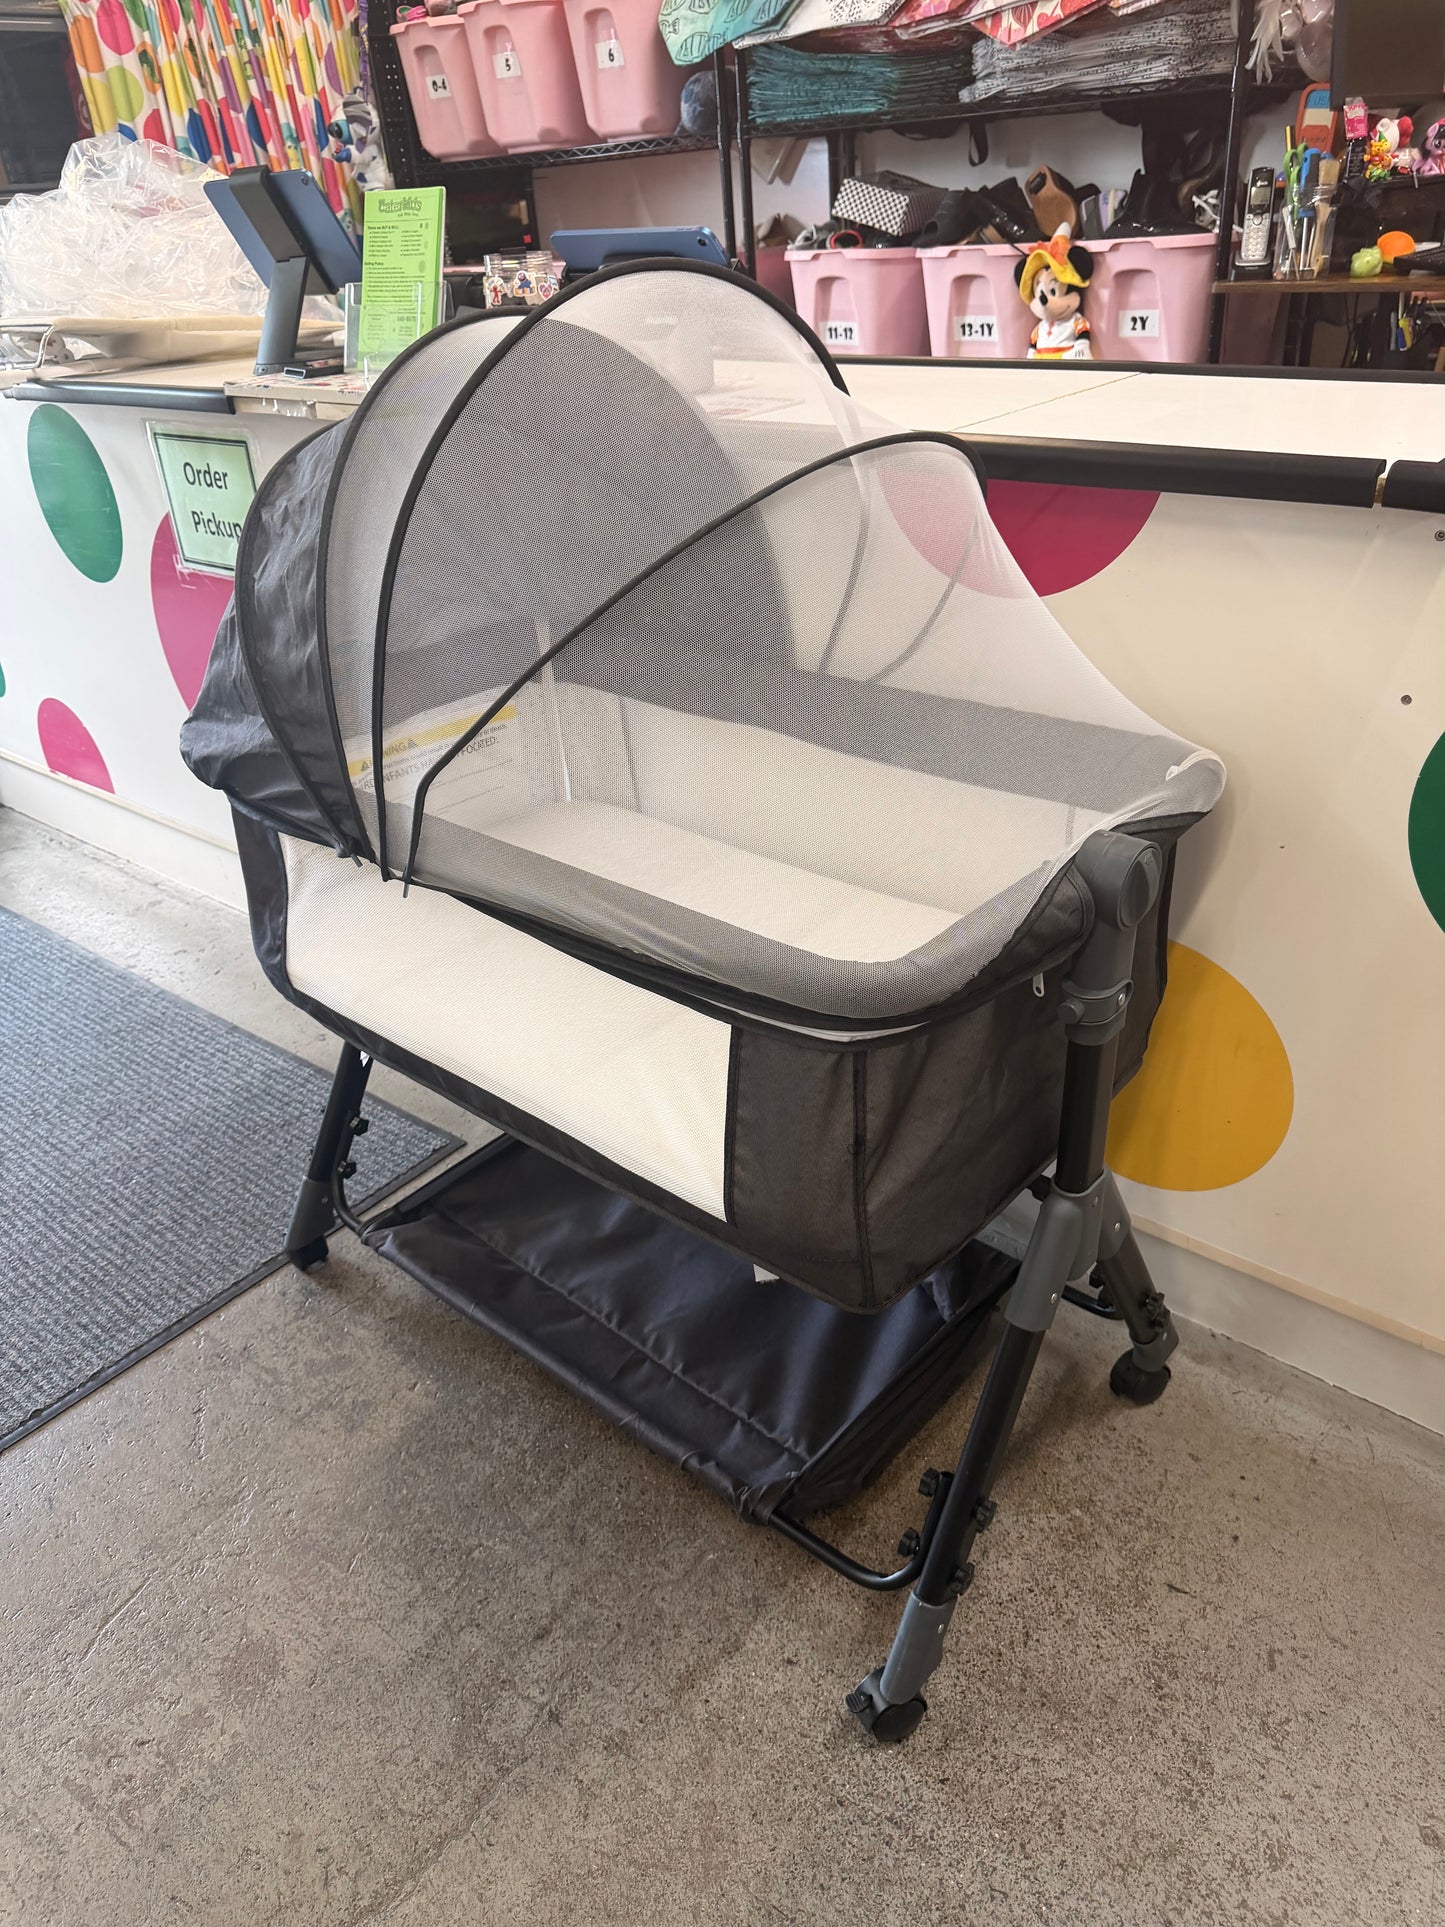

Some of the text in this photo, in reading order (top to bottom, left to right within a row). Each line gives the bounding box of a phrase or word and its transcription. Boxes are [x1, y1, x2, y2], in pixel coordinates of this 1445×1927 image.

[608, 48, 615, 62] 6
[505, 58, 513, 72] 5
[432, 79, 447, 92] 0-4
[960, 321, 994, 338] 13-1Y
[1130, 315, 1149, 331] 2Y
[827, 326, 853, 341] 11-12
[183, 461, 229, 490] Order
[191, 510, 242, 543] Pickup
